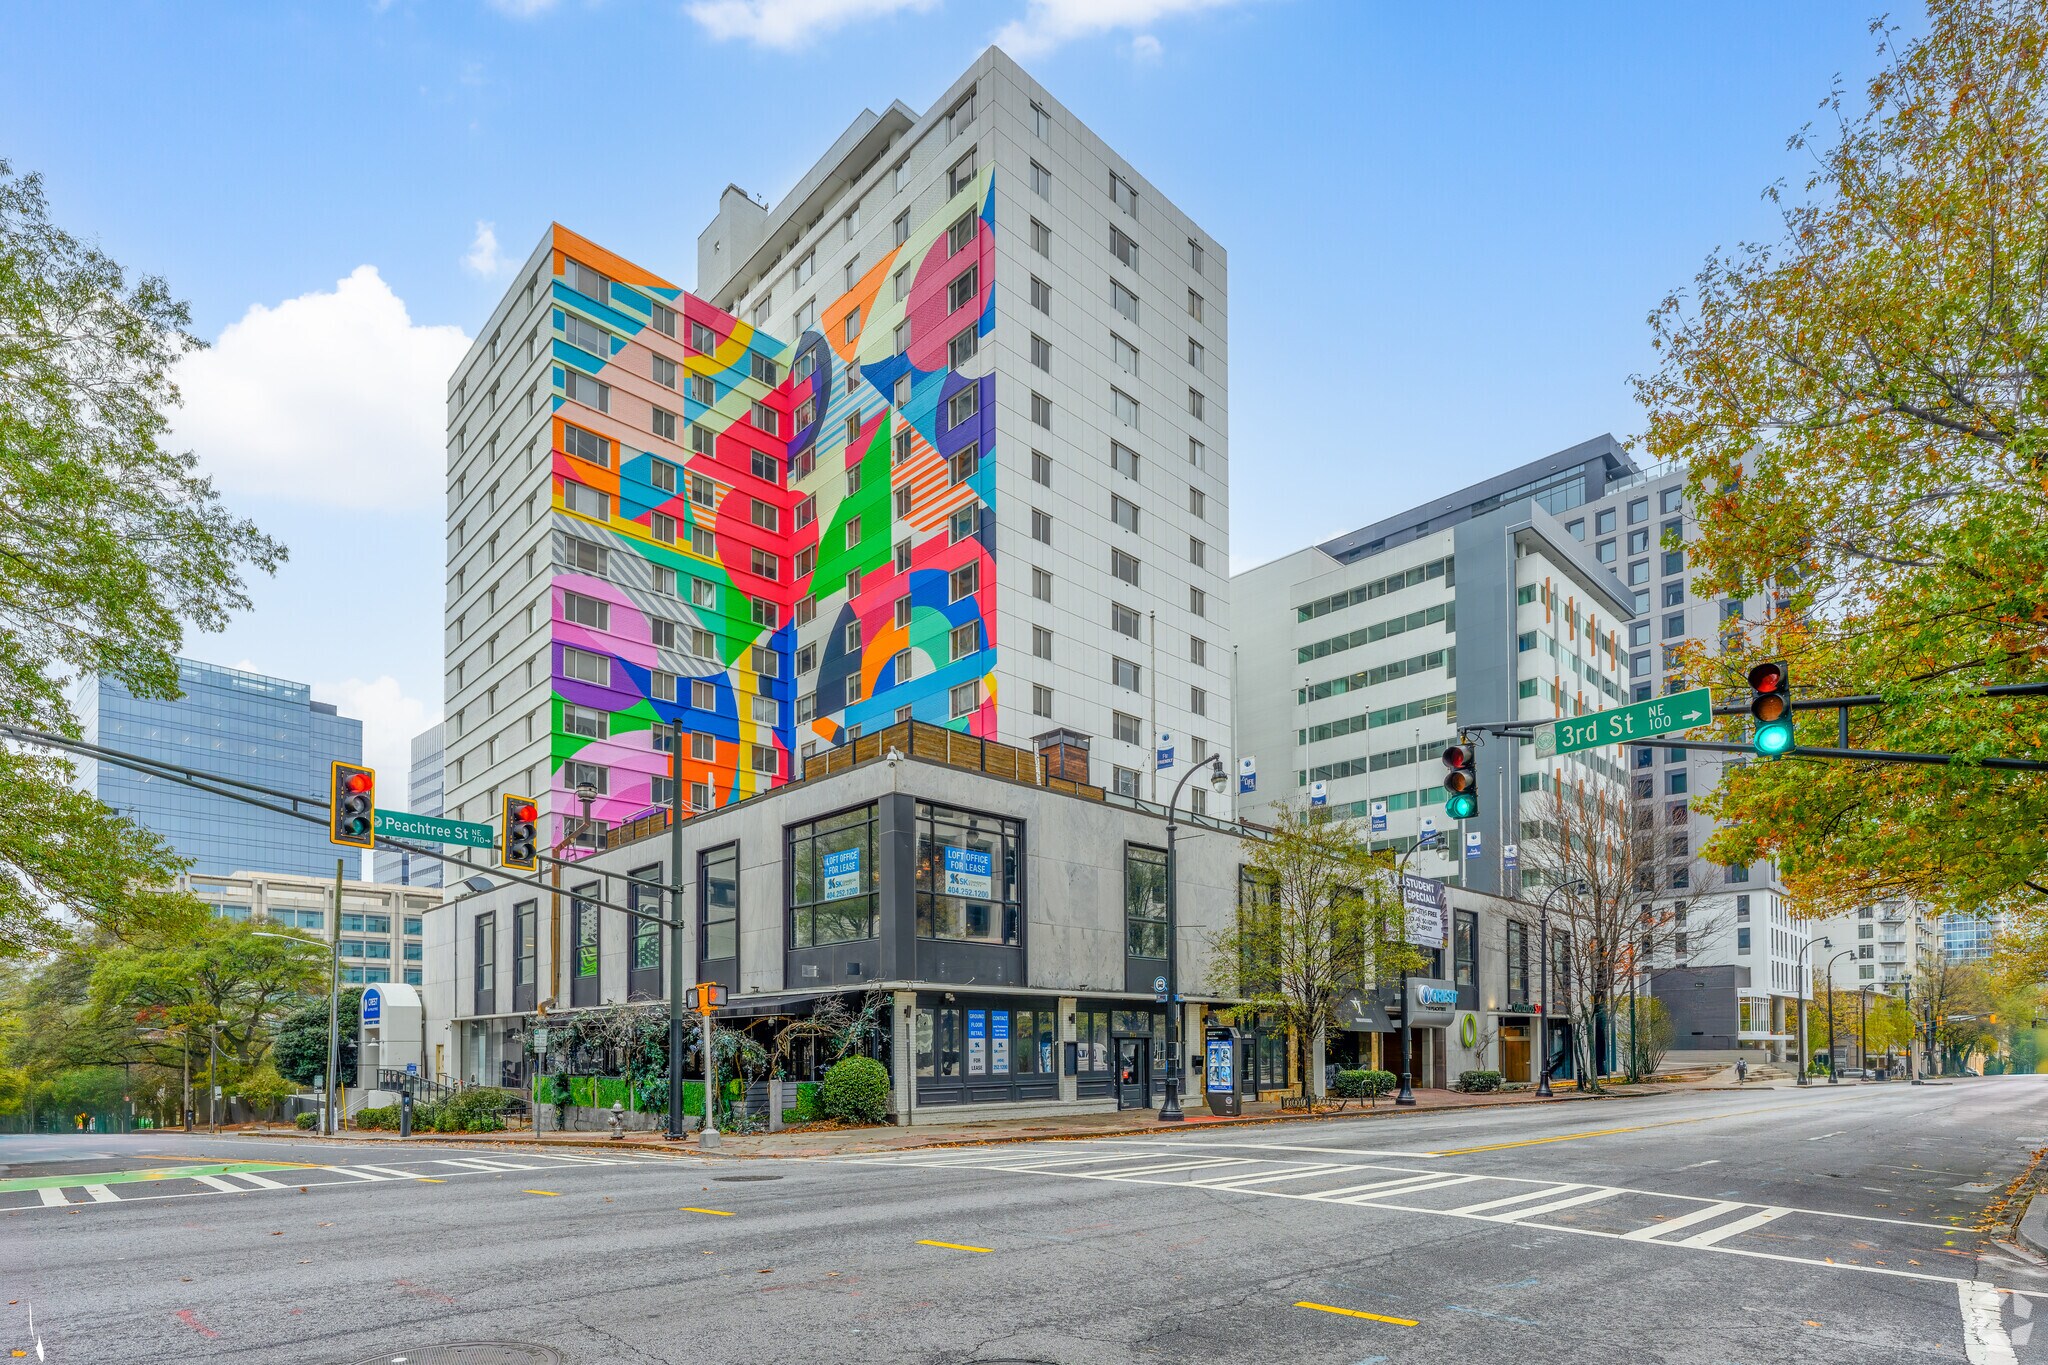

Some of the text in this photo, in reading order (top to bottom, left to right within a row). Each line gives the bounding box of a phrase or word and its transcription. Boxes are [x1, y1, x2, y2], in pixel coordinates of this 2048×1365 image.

[1648, 703, 1665, 718] NE
[1562, 712, 1634, 747] 3rd St
[1649, 715, 1671, 730] 100
[385, 816, 469, 840] Peachtree St
[471, 829, 481, 837] NE
[472, 836, 485, 844] 710
[826, 850, 858, 866] LOFT OFFICE
[947, 850, 988, 865] LOFT OFFICE
[828, 861, 856, 875] FOR LEASE
[950, 860, 986, 874] FOR LEASE
[947, 886, 990, 899] 404.252.1200
[1405, 877, 1435, 894] STUDENT
[1430, 988, 1458, 1003] CREST
